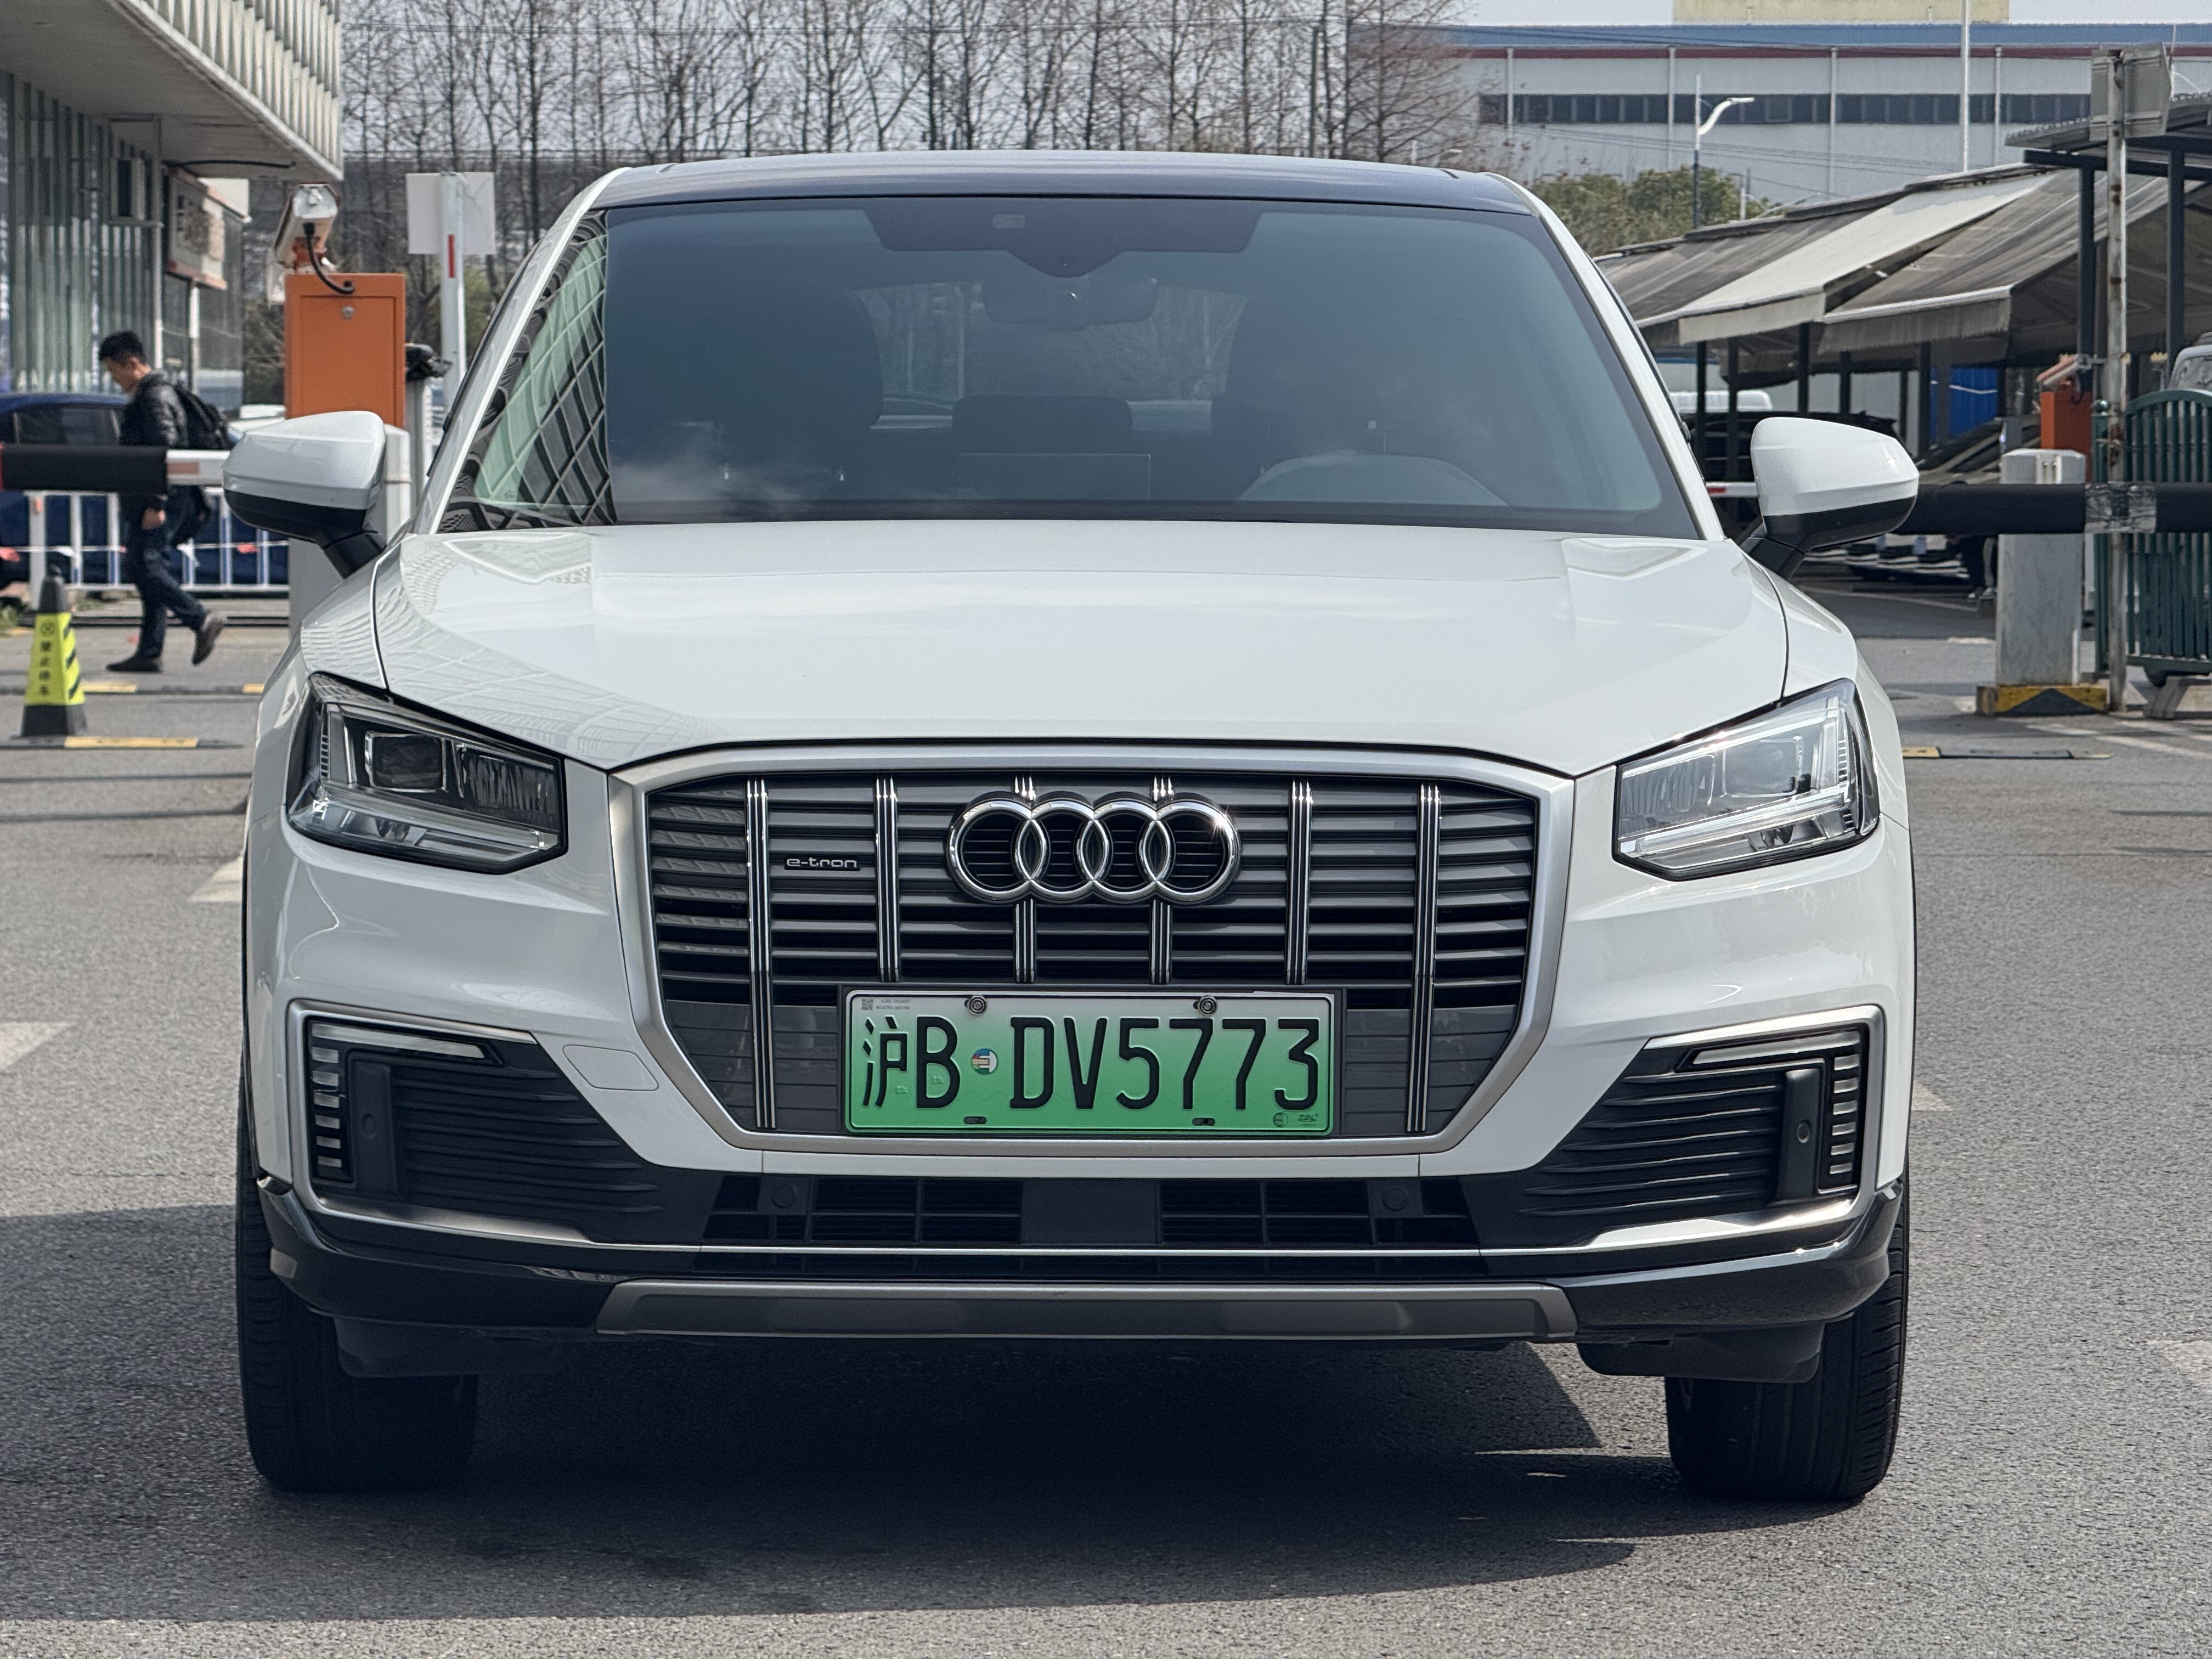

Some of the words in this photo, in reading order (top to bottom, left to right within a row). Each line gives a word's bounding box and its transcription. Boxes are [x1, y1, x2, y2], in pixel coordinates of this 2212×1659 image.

[786, 857, 857, 868] e-tron
[862, 1016, 961, 1108] 沪B
[1009, 1017, 1319, 1110] DV5773
